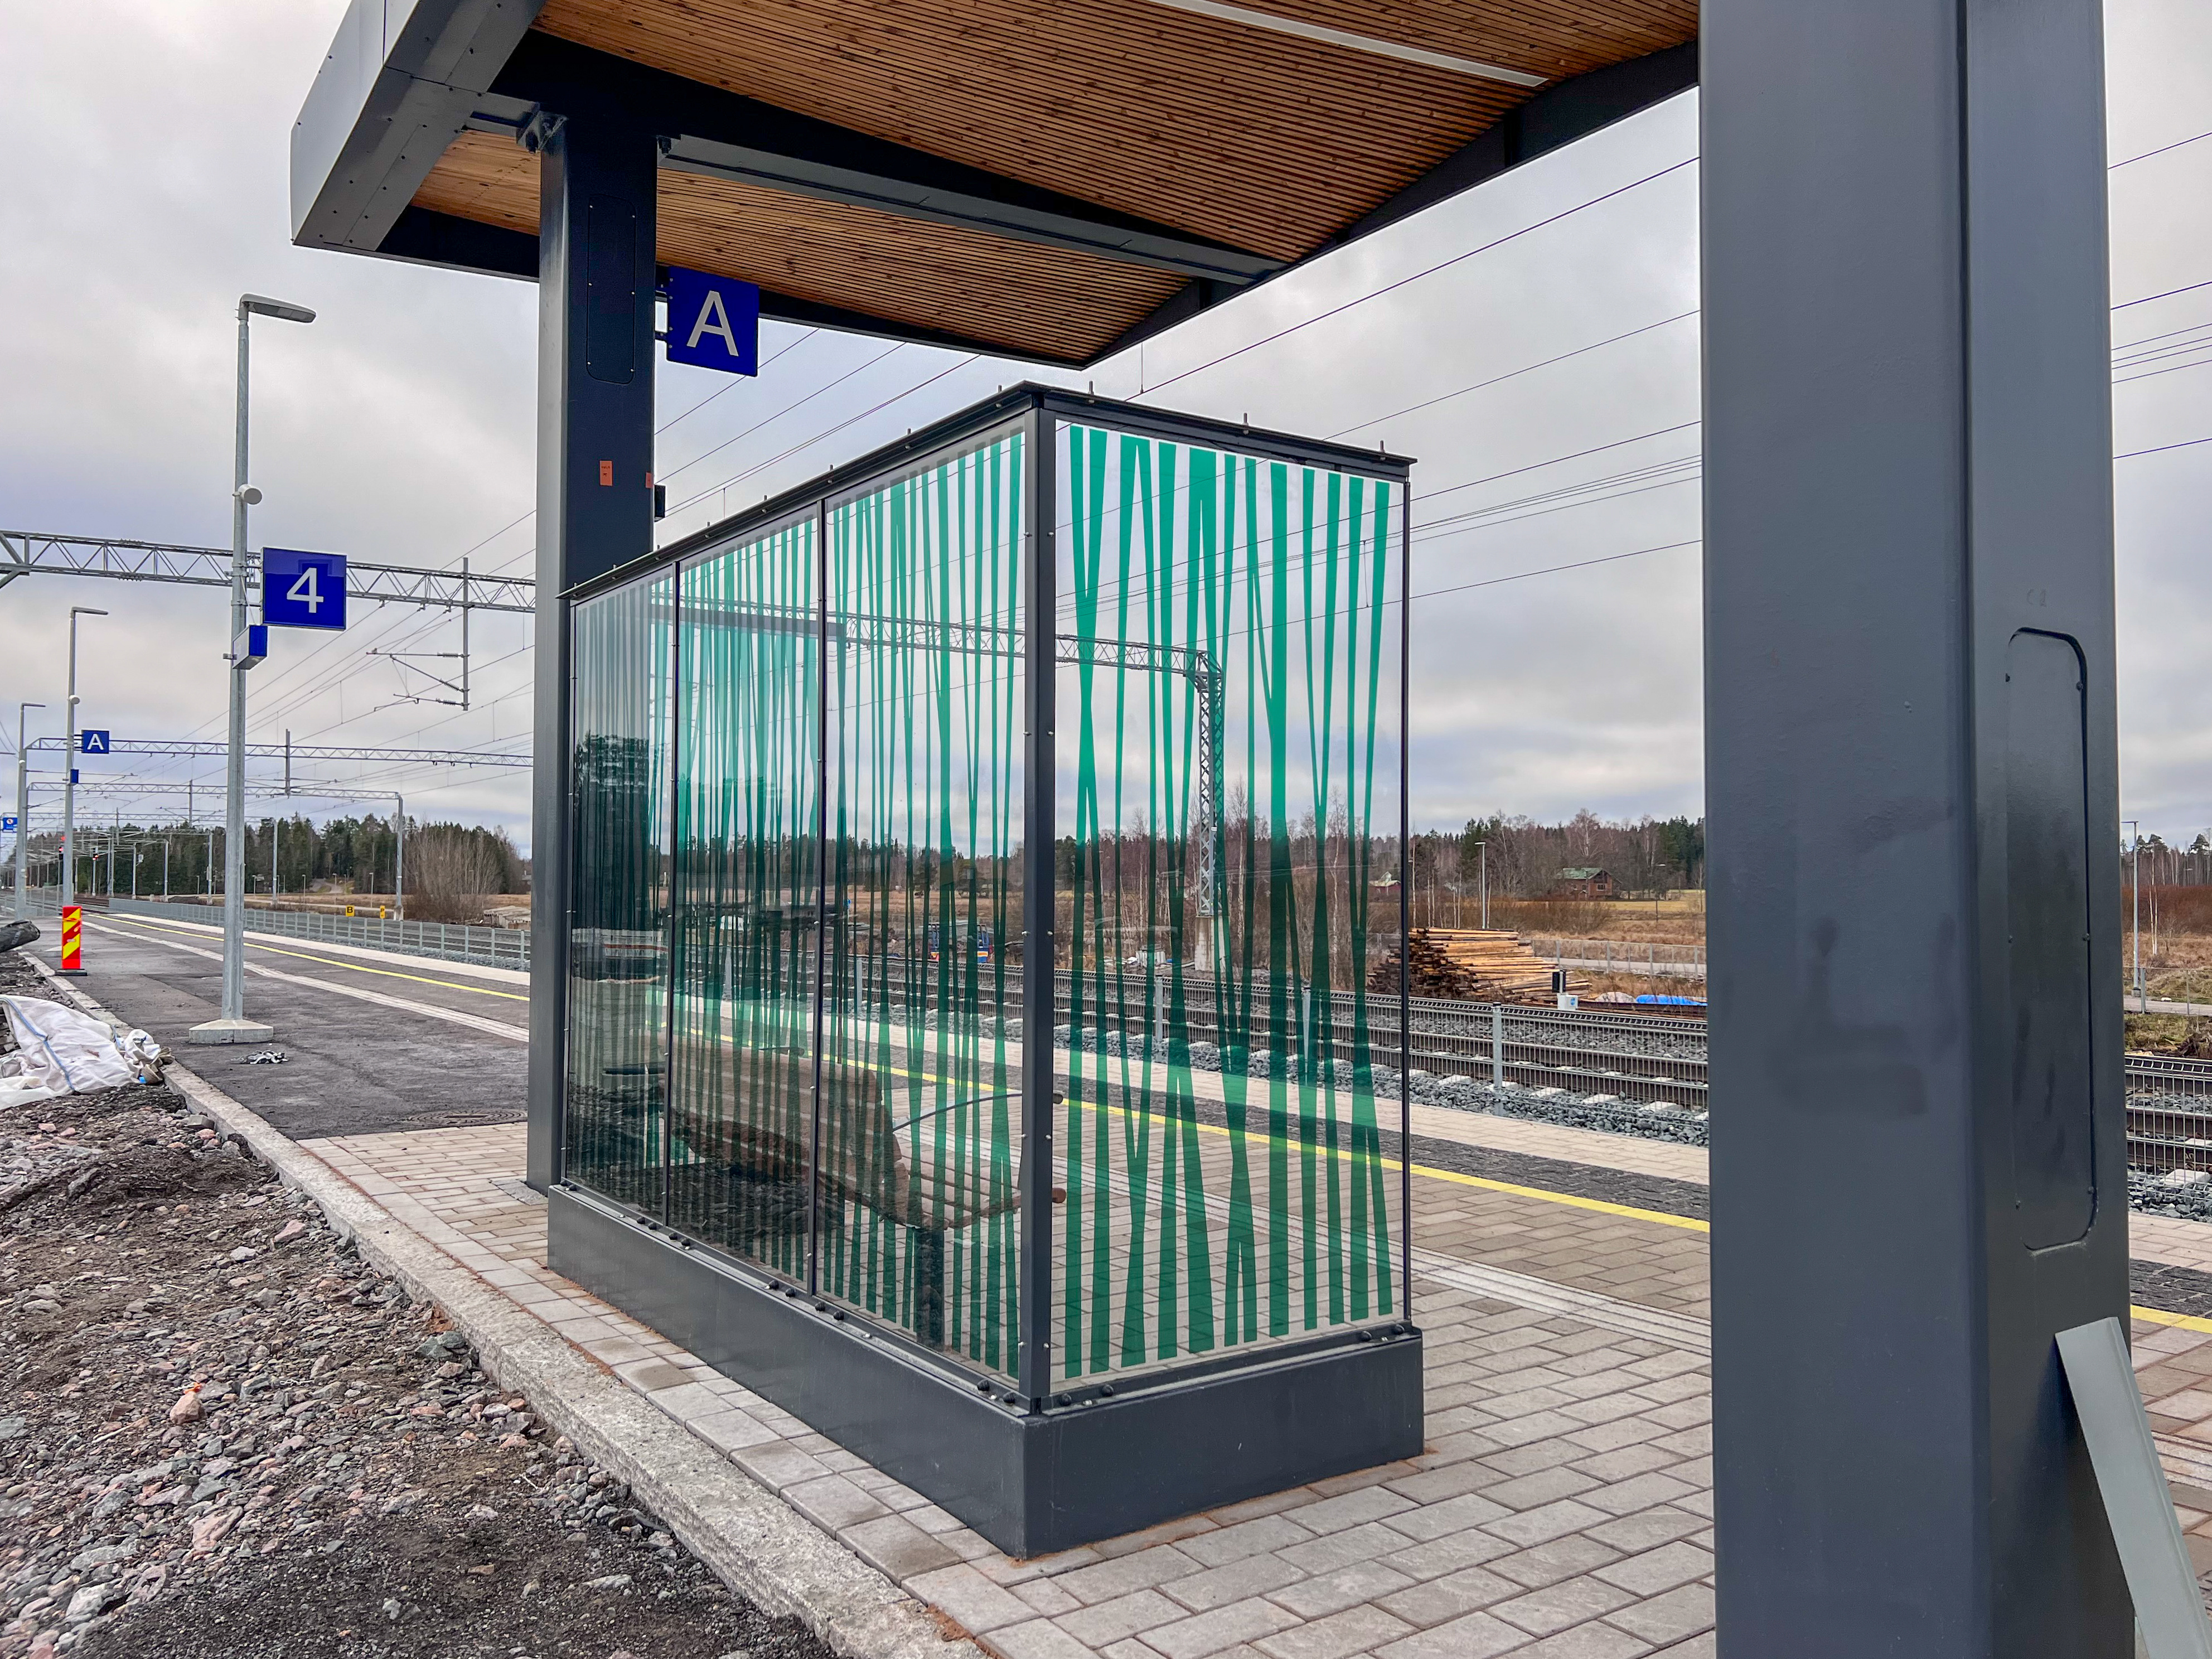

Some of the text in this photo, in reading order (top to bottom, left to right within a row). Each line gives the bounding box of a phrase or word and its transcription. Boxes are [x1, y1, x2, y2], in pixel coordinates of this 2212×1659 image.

[686, 290, 739, 357] A
[286, 567, 324, 613] 4
[86, 733, 104, 751] A
